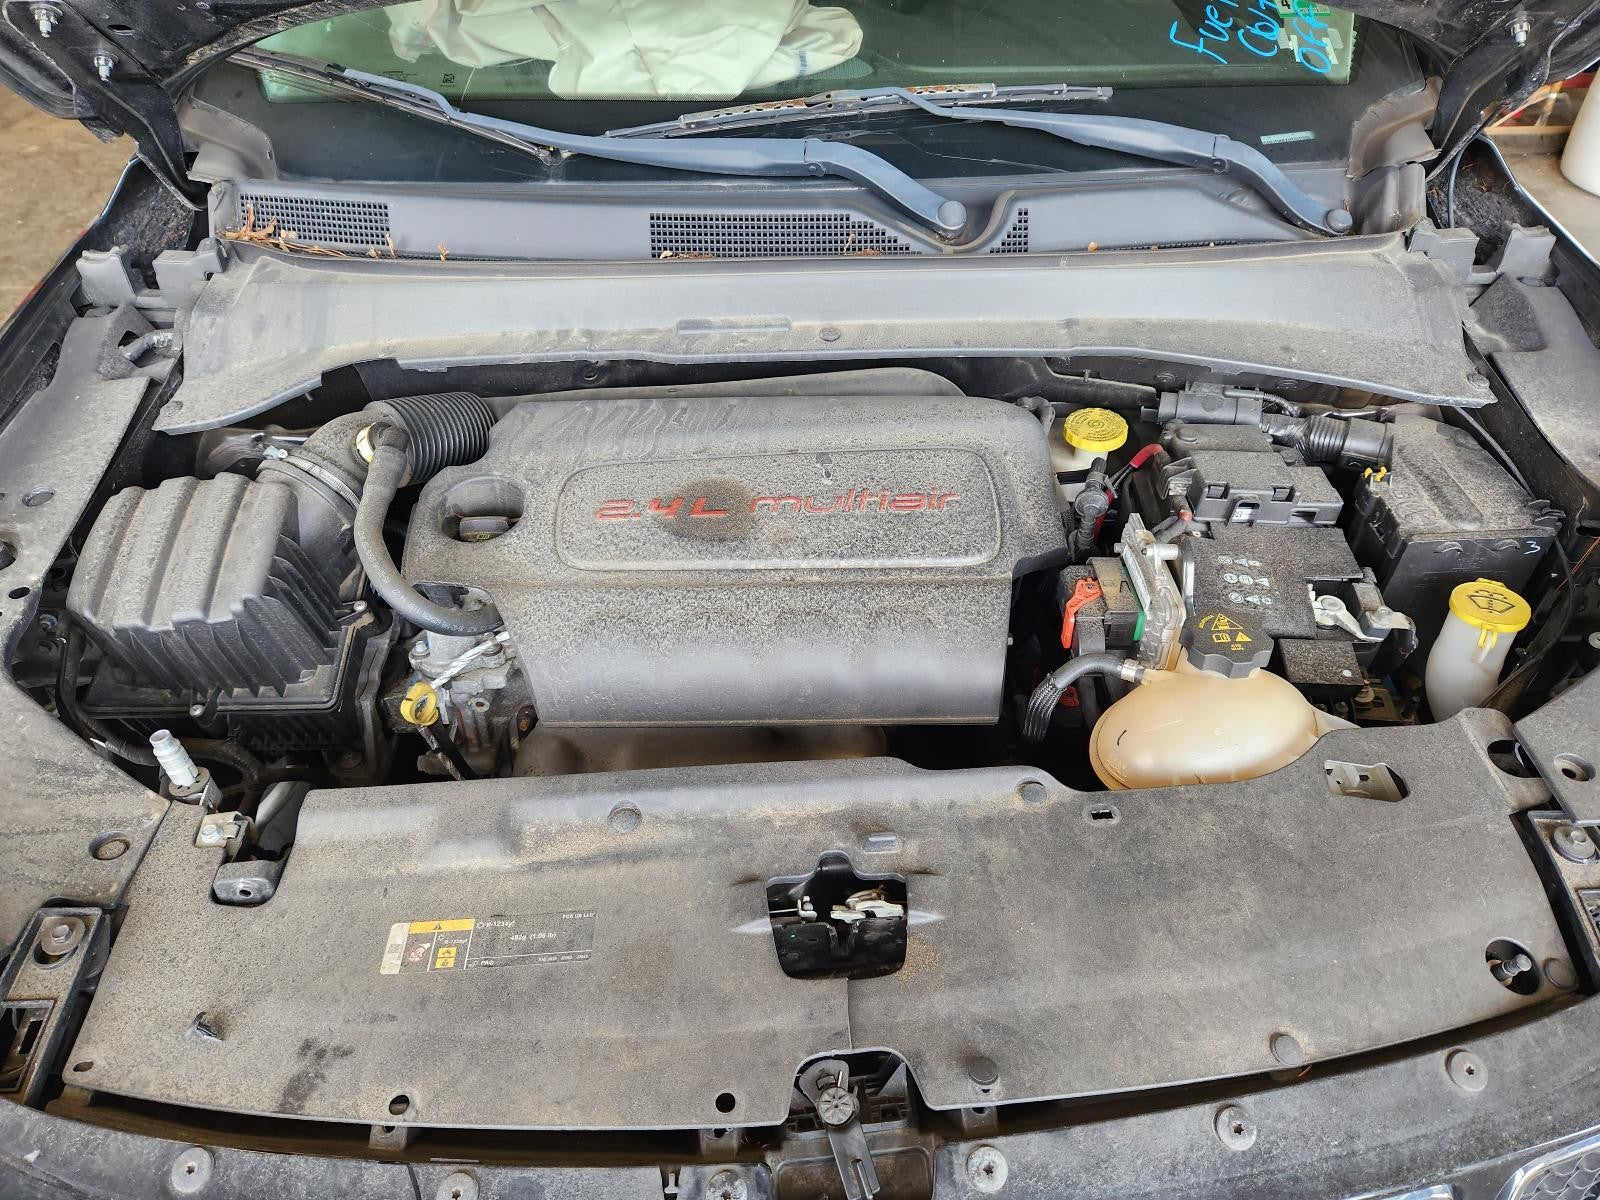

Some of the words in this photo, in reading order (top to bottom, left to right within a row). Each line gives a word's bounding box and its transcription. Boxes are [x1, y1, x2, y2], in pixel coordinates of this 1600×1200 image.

[594, 496, 729, 518] 2.4L
[747, 487, 959, 514] multiair
[1523, 540, 1541, 555] 3
